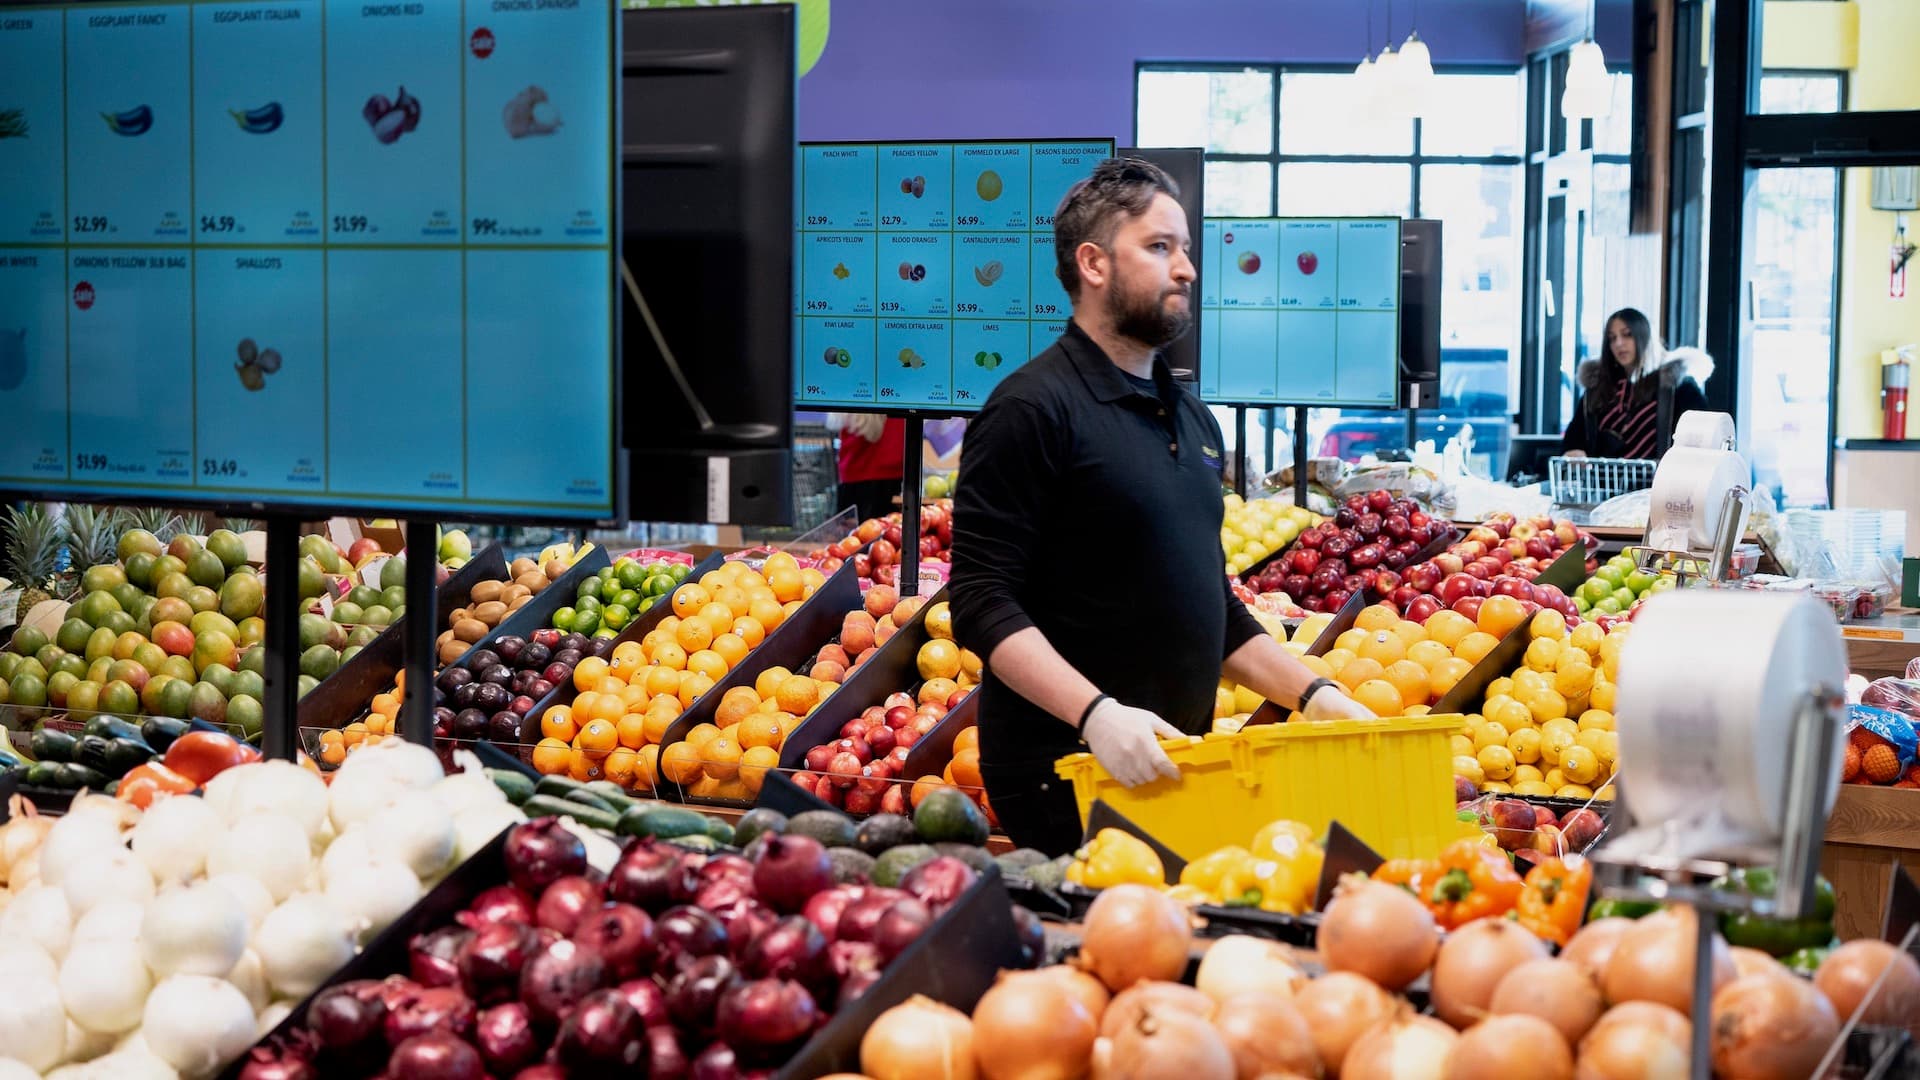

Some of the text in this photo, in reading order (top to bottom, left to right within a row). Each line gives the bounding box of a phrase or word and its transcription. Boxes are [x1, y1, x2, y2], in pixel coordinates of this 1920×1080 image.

[213, 8, 301, 24] EGGPLANT ITALIAN
[361, 5, 424, 17] ONIONS RED
[4, 19, 33, 31] GREEN
[89, 14, 167, 28] EGGPLANT FANCY
[841, 150, 859, 158] WHITE
[963, 148, 994, 156] POMMELO
[1061, 157, 1080, 165] SLICES
[73, 216, 108, 233] $2.99
[201, 216, 236, 233] $4.59
[333, 216, 368, 233] $1.99
[807, 215, 828, 225] $2.99
[881, 215, 901, 225] $2.79
[957, 215, 979, 226] $6.99
[1035, 215, 1056, 226] $5.49
[472, 217, 498, 236] 99¢
[842, 236, 864, 244] YELLOW
[891, 236, 938, 244] BLOOD ORANGES
[962, 236, 999, 244] CANTALOUPE
[10, 256, 38, 268] WHITE
[74, 257, 110, 268] ONIONS
[110, 257, 147, 268] YELLOW
[167, 257, 187, 269] BAG
[235, 258, 283, 270] SHALLOTS
[807, 300, 827, 311] $4.99
[881, 301, 900, 312] $1.39
[957, 303, 977, 313] $5.99
[1034, 304, 1056, 315] $3.99
[838, 321, 855, 329] LARGE
[884, 322, 944, 331] LEMONS EXTRA LARGE
[982, 324, 1000, 332] LIMES
[807, 385, 820, 395] 99¢
[880, 387, 894, 398] 69¢
[956, 389, 969, 400] 79¢
[76, 453, 108, 471] $1.99
[203, 459, 237, 477] $3.49
